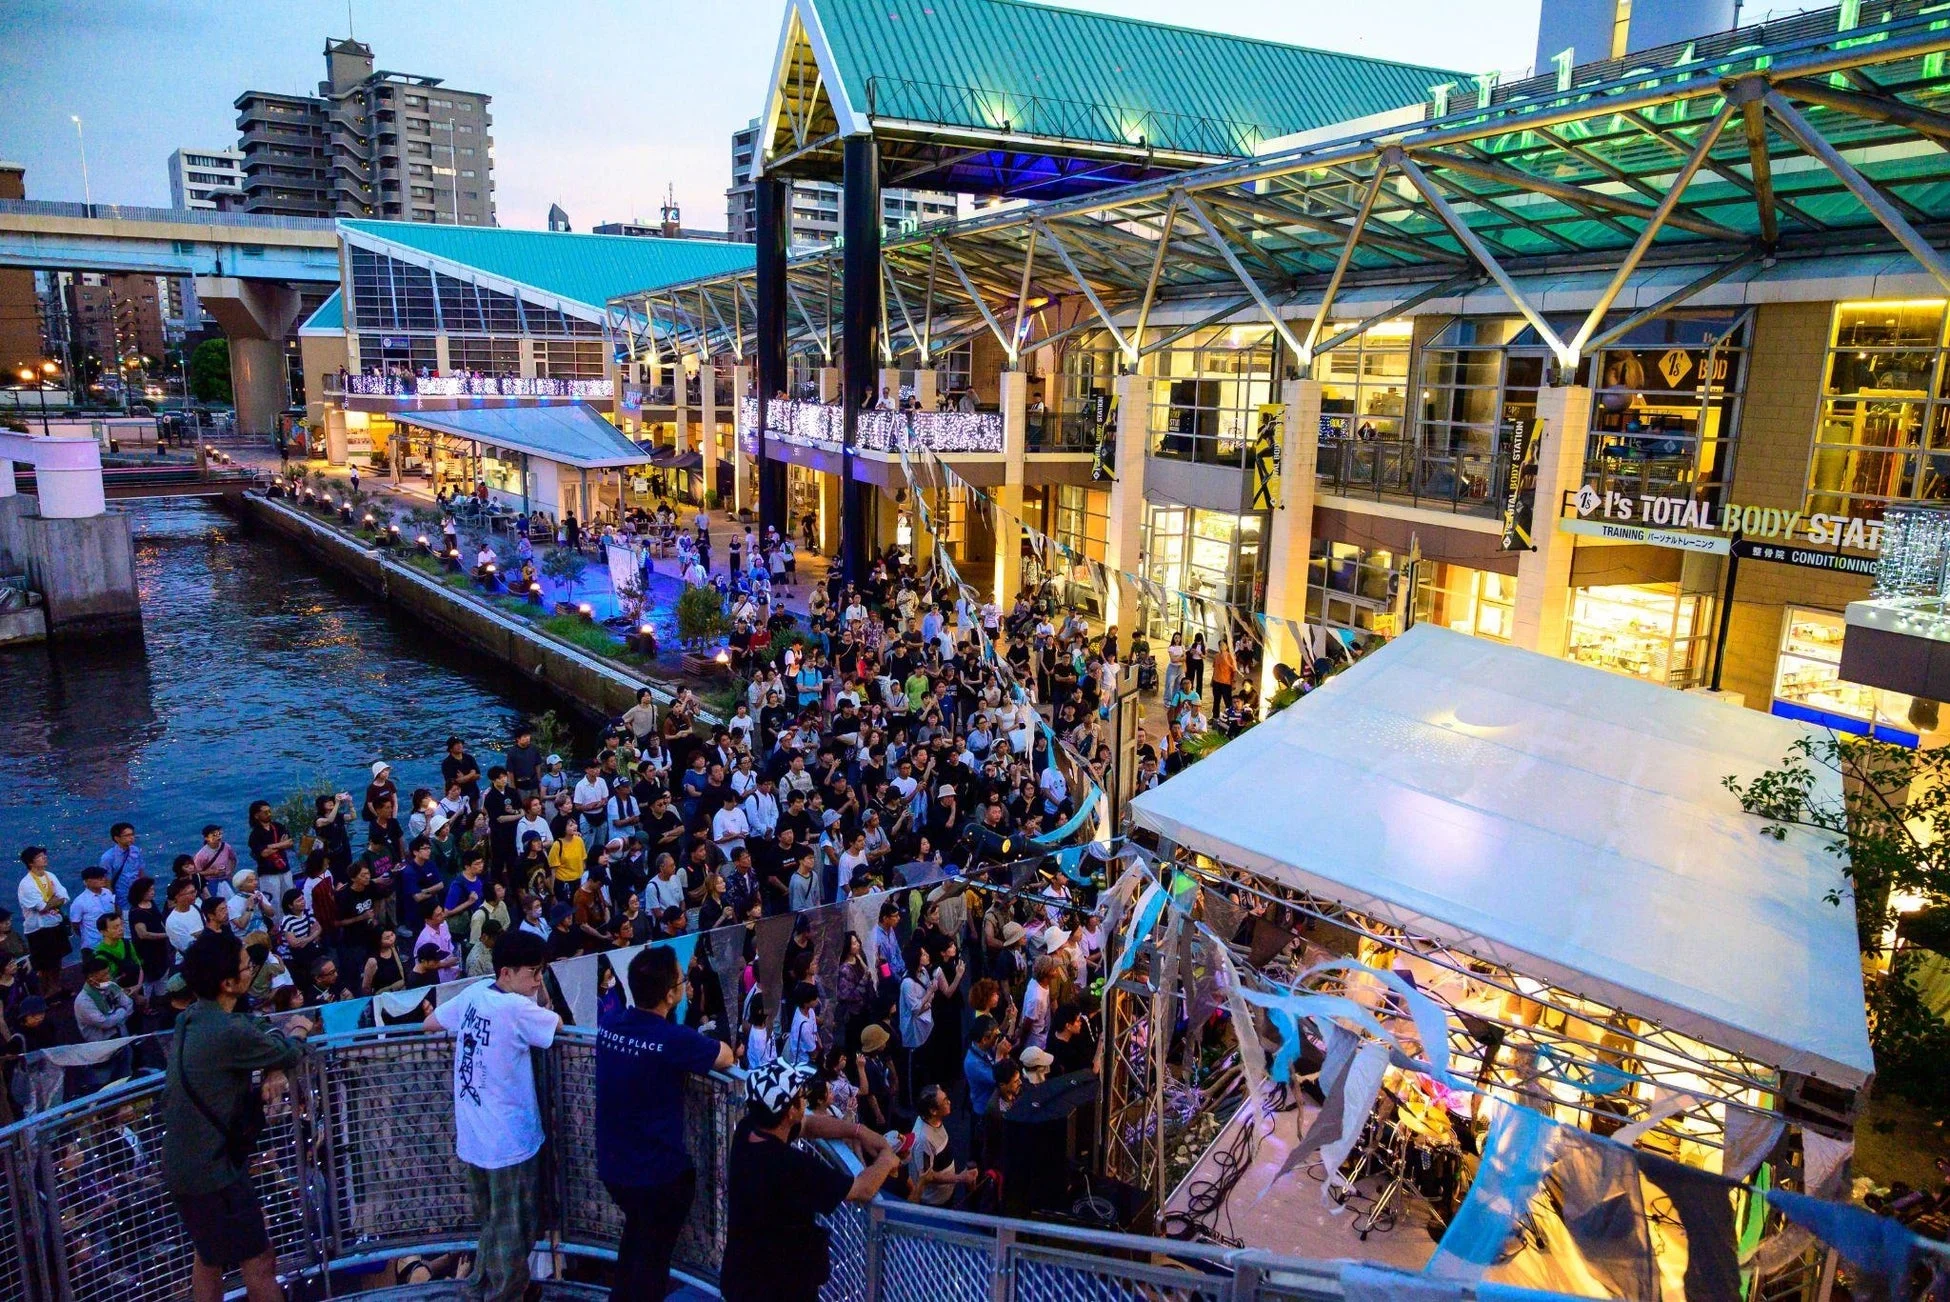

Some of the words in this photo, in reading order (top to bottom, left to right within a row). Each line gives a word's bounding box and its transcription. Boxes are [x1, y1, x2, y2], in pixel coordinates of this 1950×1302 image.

[1512, 420, 1524, 461] STATION
[1509, 463, 1520, 490] BODY
[1603, 490, 1634, 520] I's
[1639, 494, 1716, 530] TOTAL
[1721, 503, 1801, 541] BODY
[1602, 525, 1644, 541] TRAINING
[1647, 532, 1715, 549] パーソナルトレーニング
[1752, 546, 1785, 561] 整骨院
[1791, 550, 1878, 574] CONDITIONING
[628, 1038, 664, 1052] PLACE
